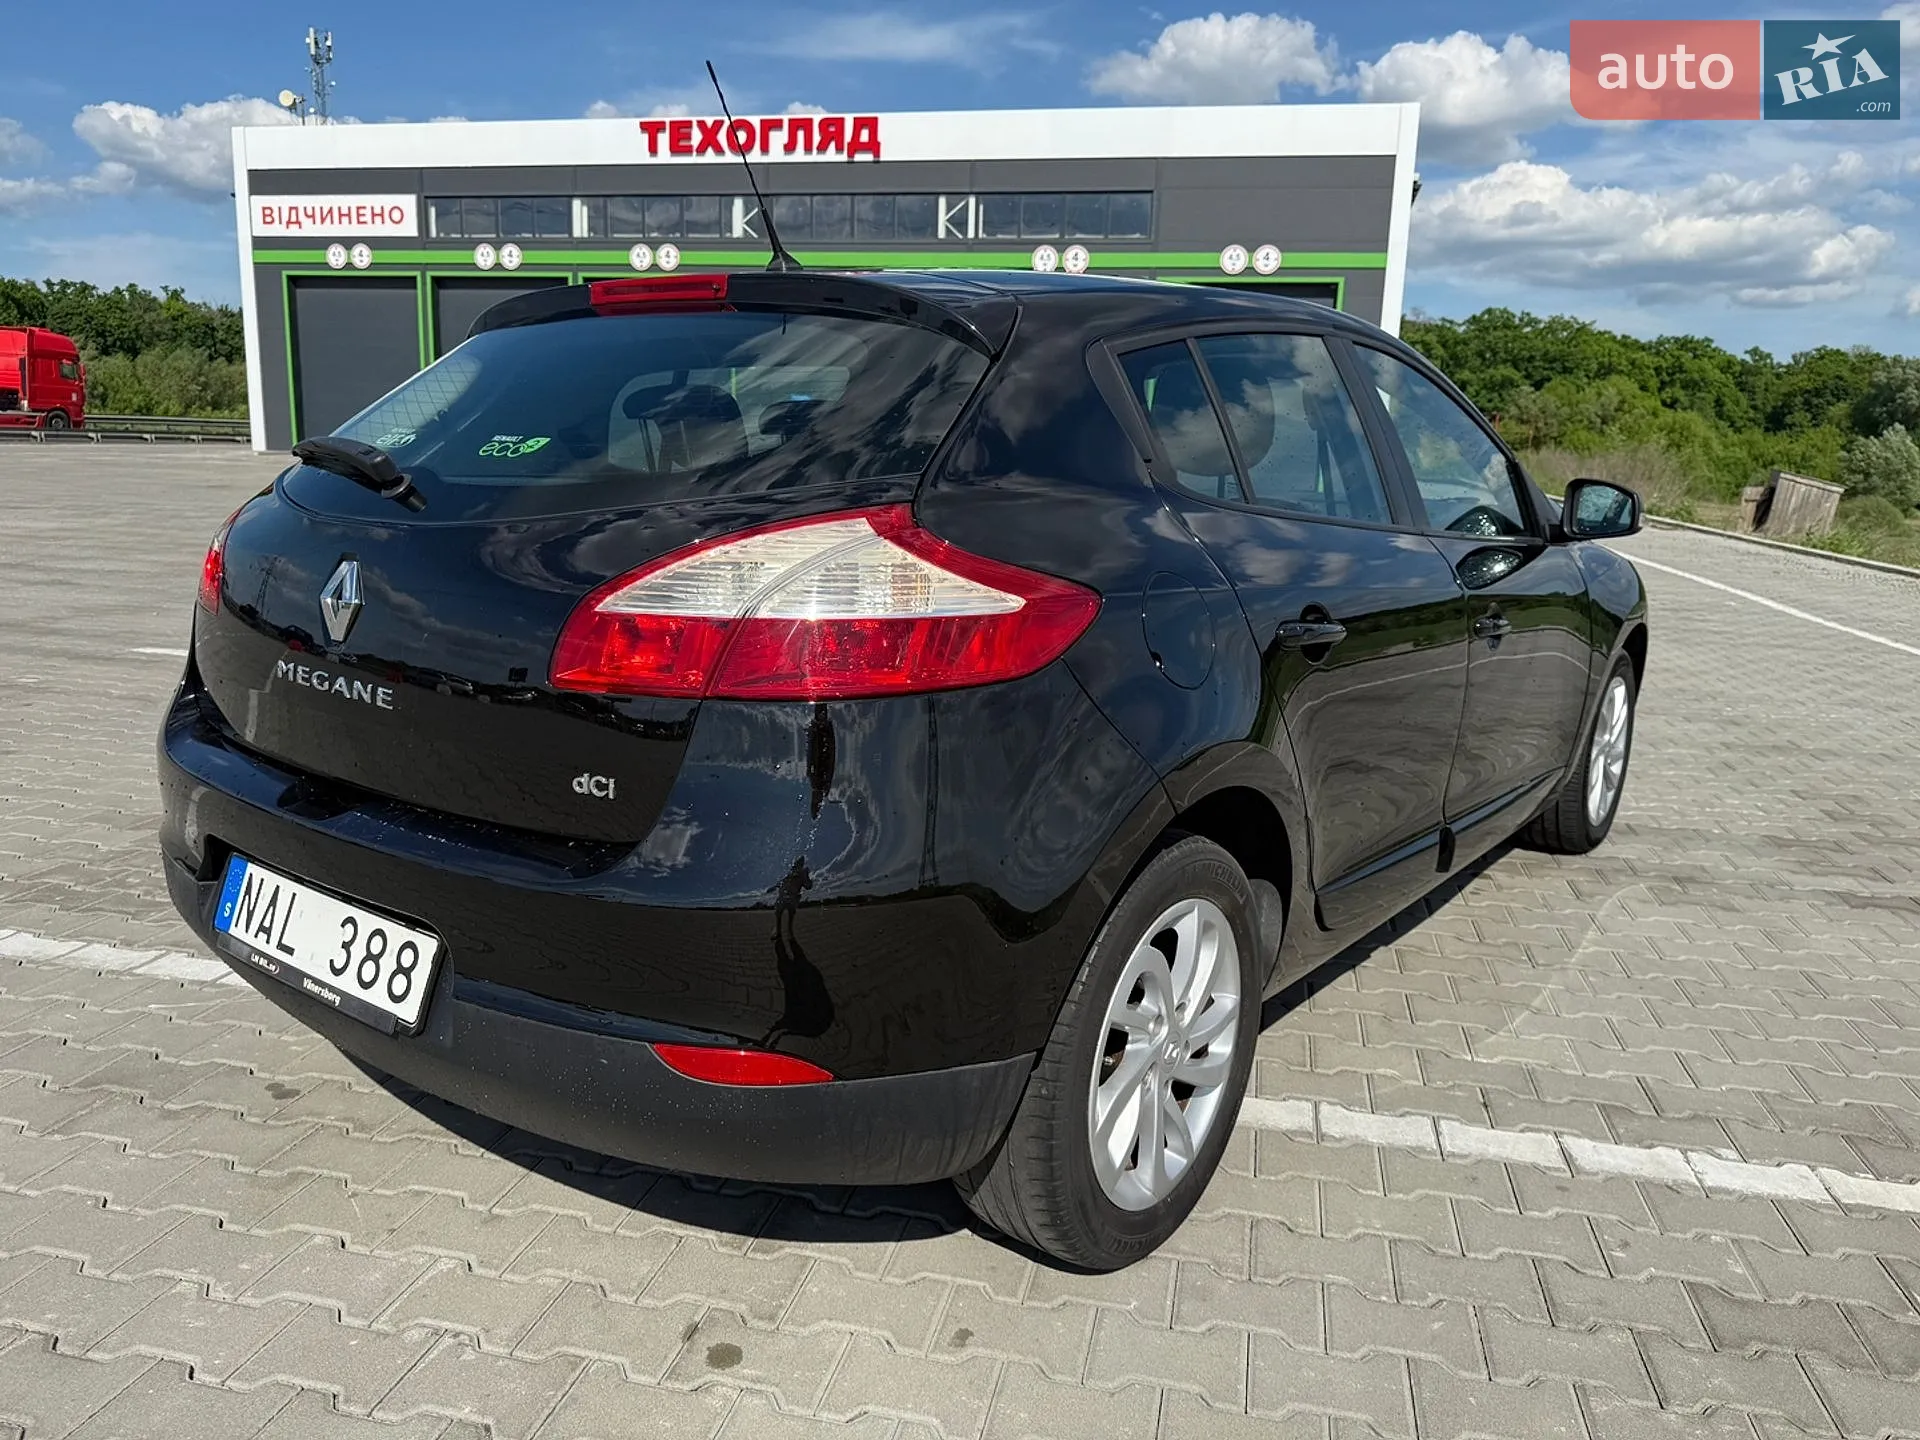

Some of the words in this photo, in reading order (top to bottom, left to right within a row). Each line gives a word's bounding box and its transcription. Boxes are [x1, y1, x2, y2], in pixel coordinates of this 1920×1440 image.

[639, 116, 881, 163] ТЕХОГЛЯД
[261, 206, 404, 229] ВІДЧИНЕНО
[276, 659, 394, 711] MEGANE
[223, 902, 232, 918] S
[235, 872, 297, 957] NAL
[329, 916, 420, 1004] 388
